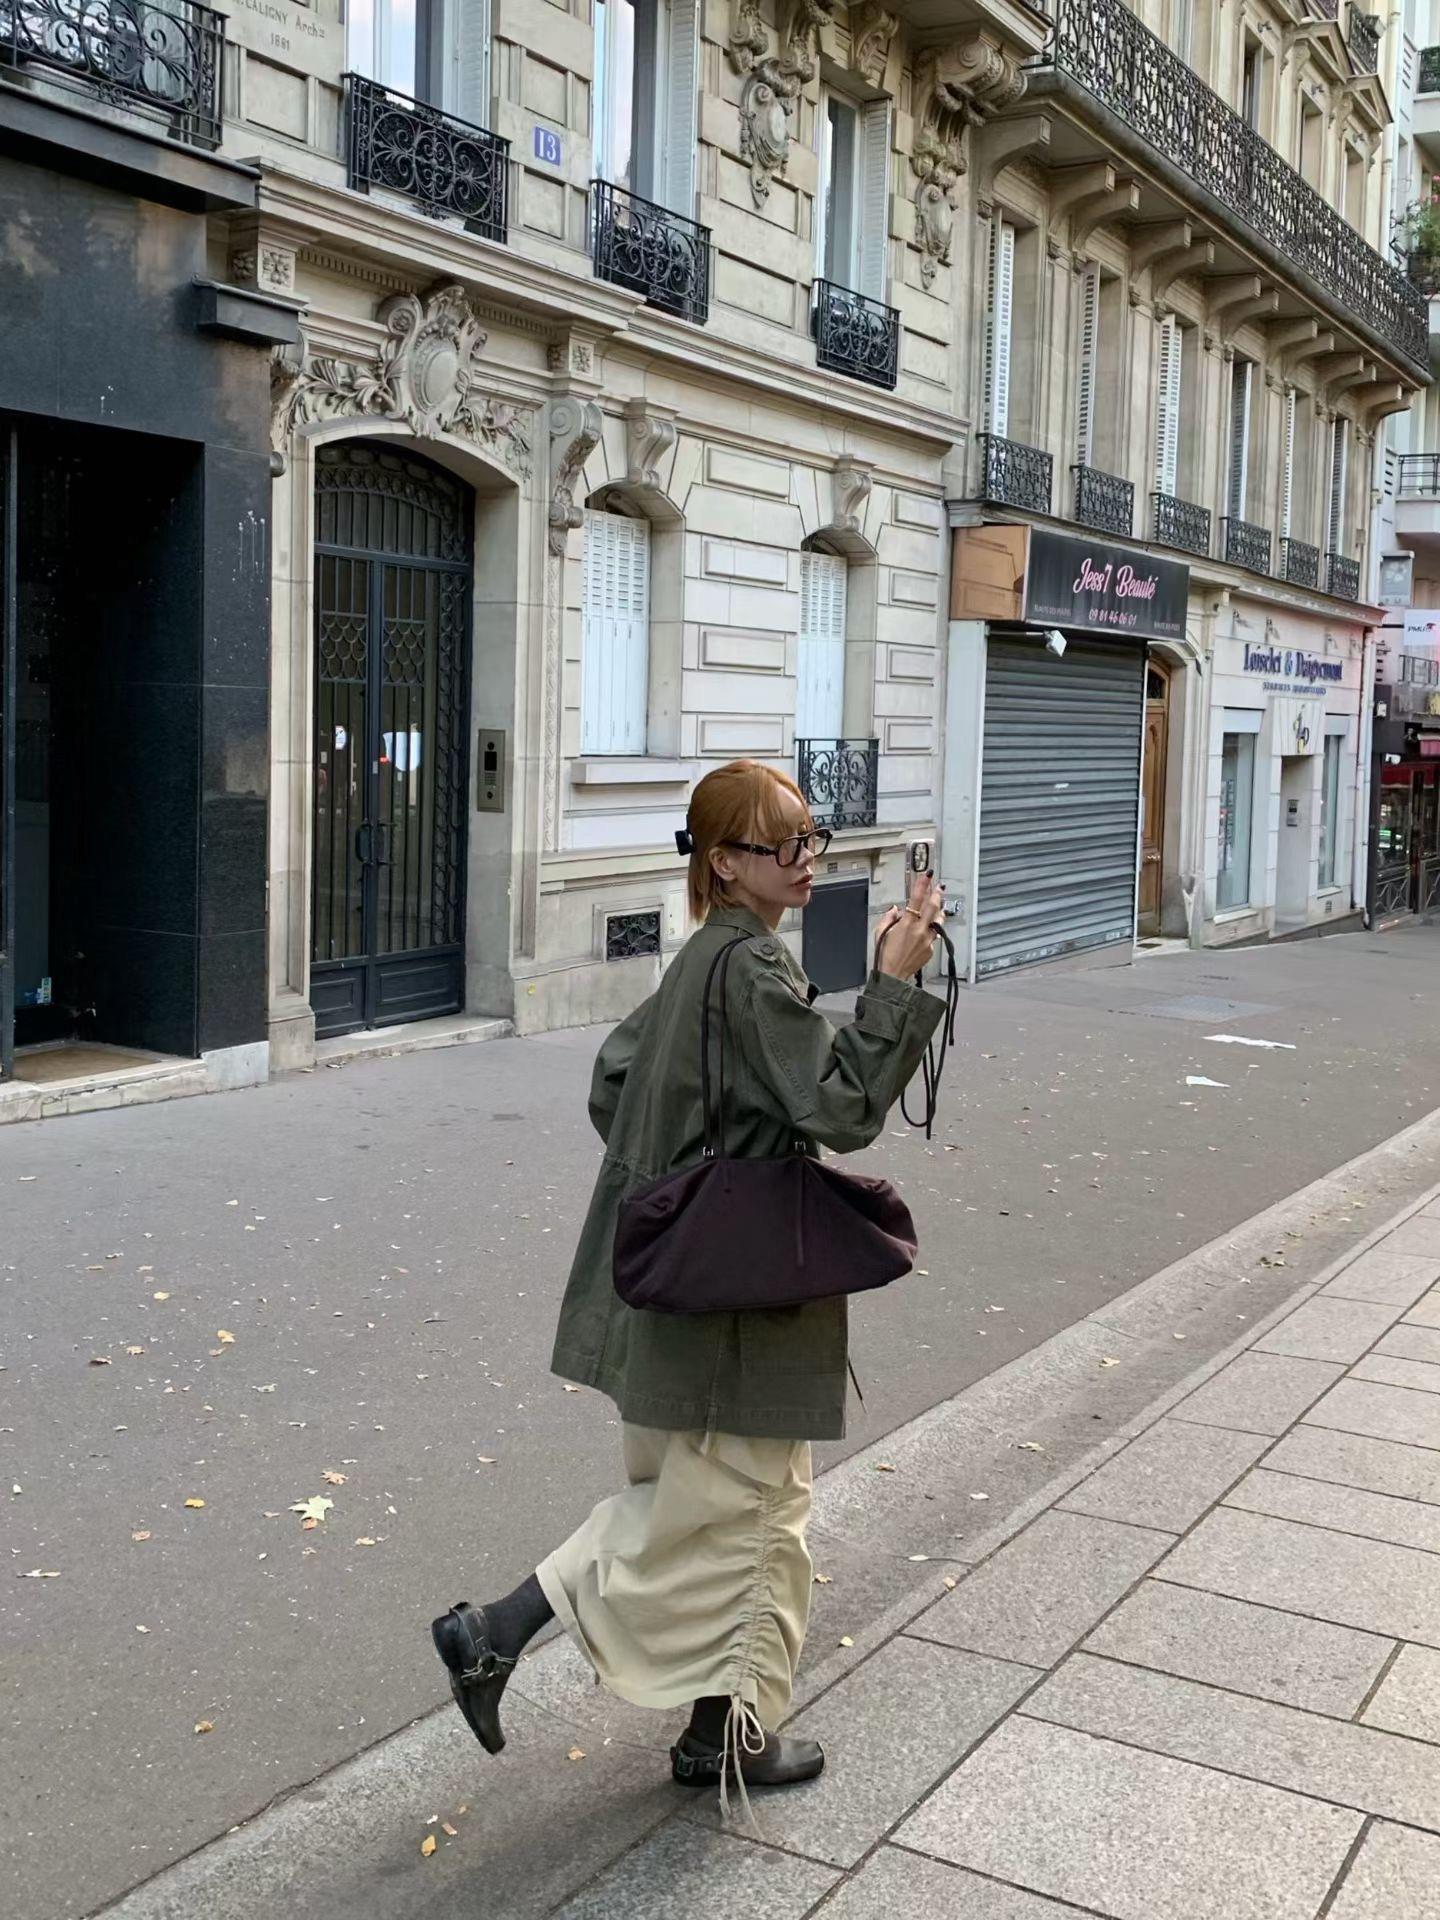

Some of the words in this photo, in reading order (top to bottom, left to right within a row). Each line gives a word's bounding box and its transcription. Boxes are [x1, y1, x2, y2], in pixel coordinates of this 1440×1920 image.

[539, 130, 557, 161] 13
[1073, 558, 1113, 594] Jess7
[1115, 565, 1159, 600] Beauté
